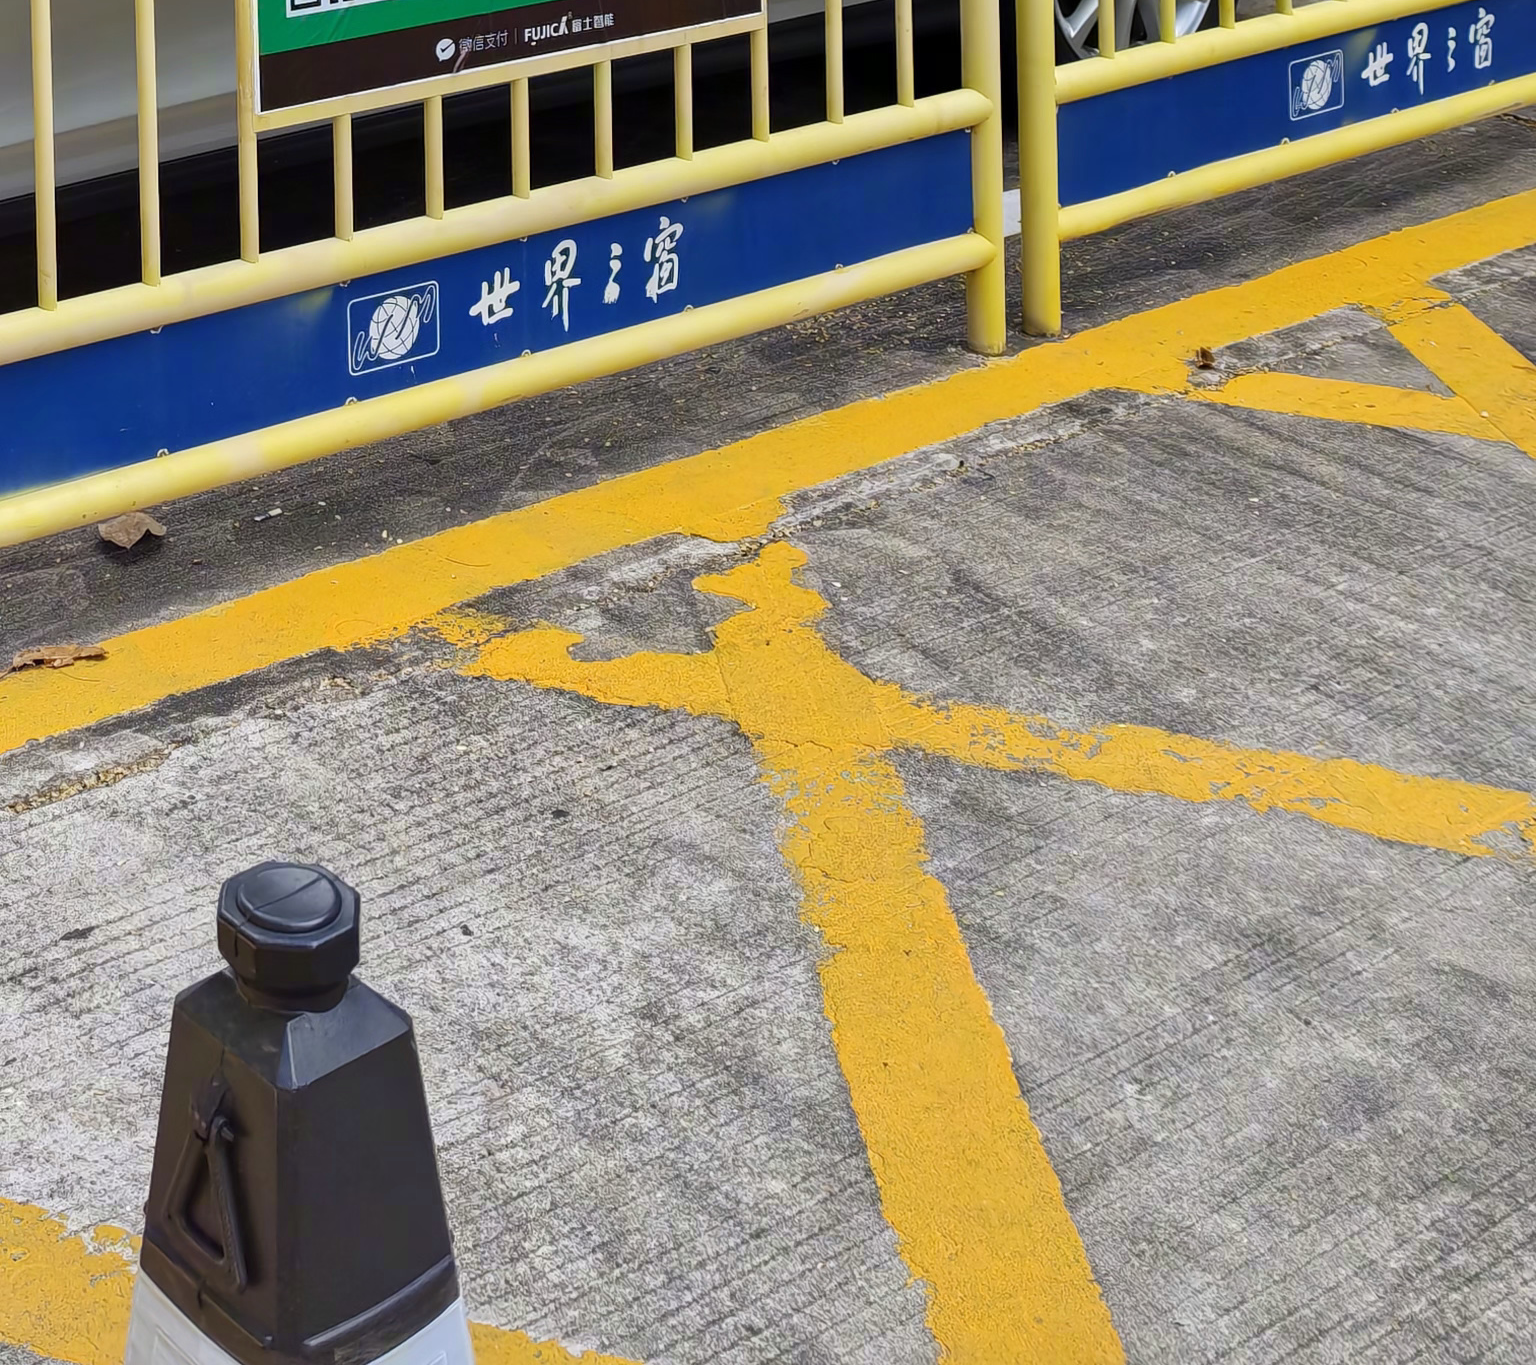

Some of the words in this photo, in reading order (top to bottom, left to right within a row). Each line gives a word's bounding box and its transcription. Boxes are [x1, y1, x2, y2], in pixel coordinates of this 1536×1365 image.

[458, 29, 509, 52] 微信支付
[524, 15, 569, 43] FUJICA
[1361, 6, 1495, 95] 世界之窗
[469, 215, 684, 332] 世界之窗
